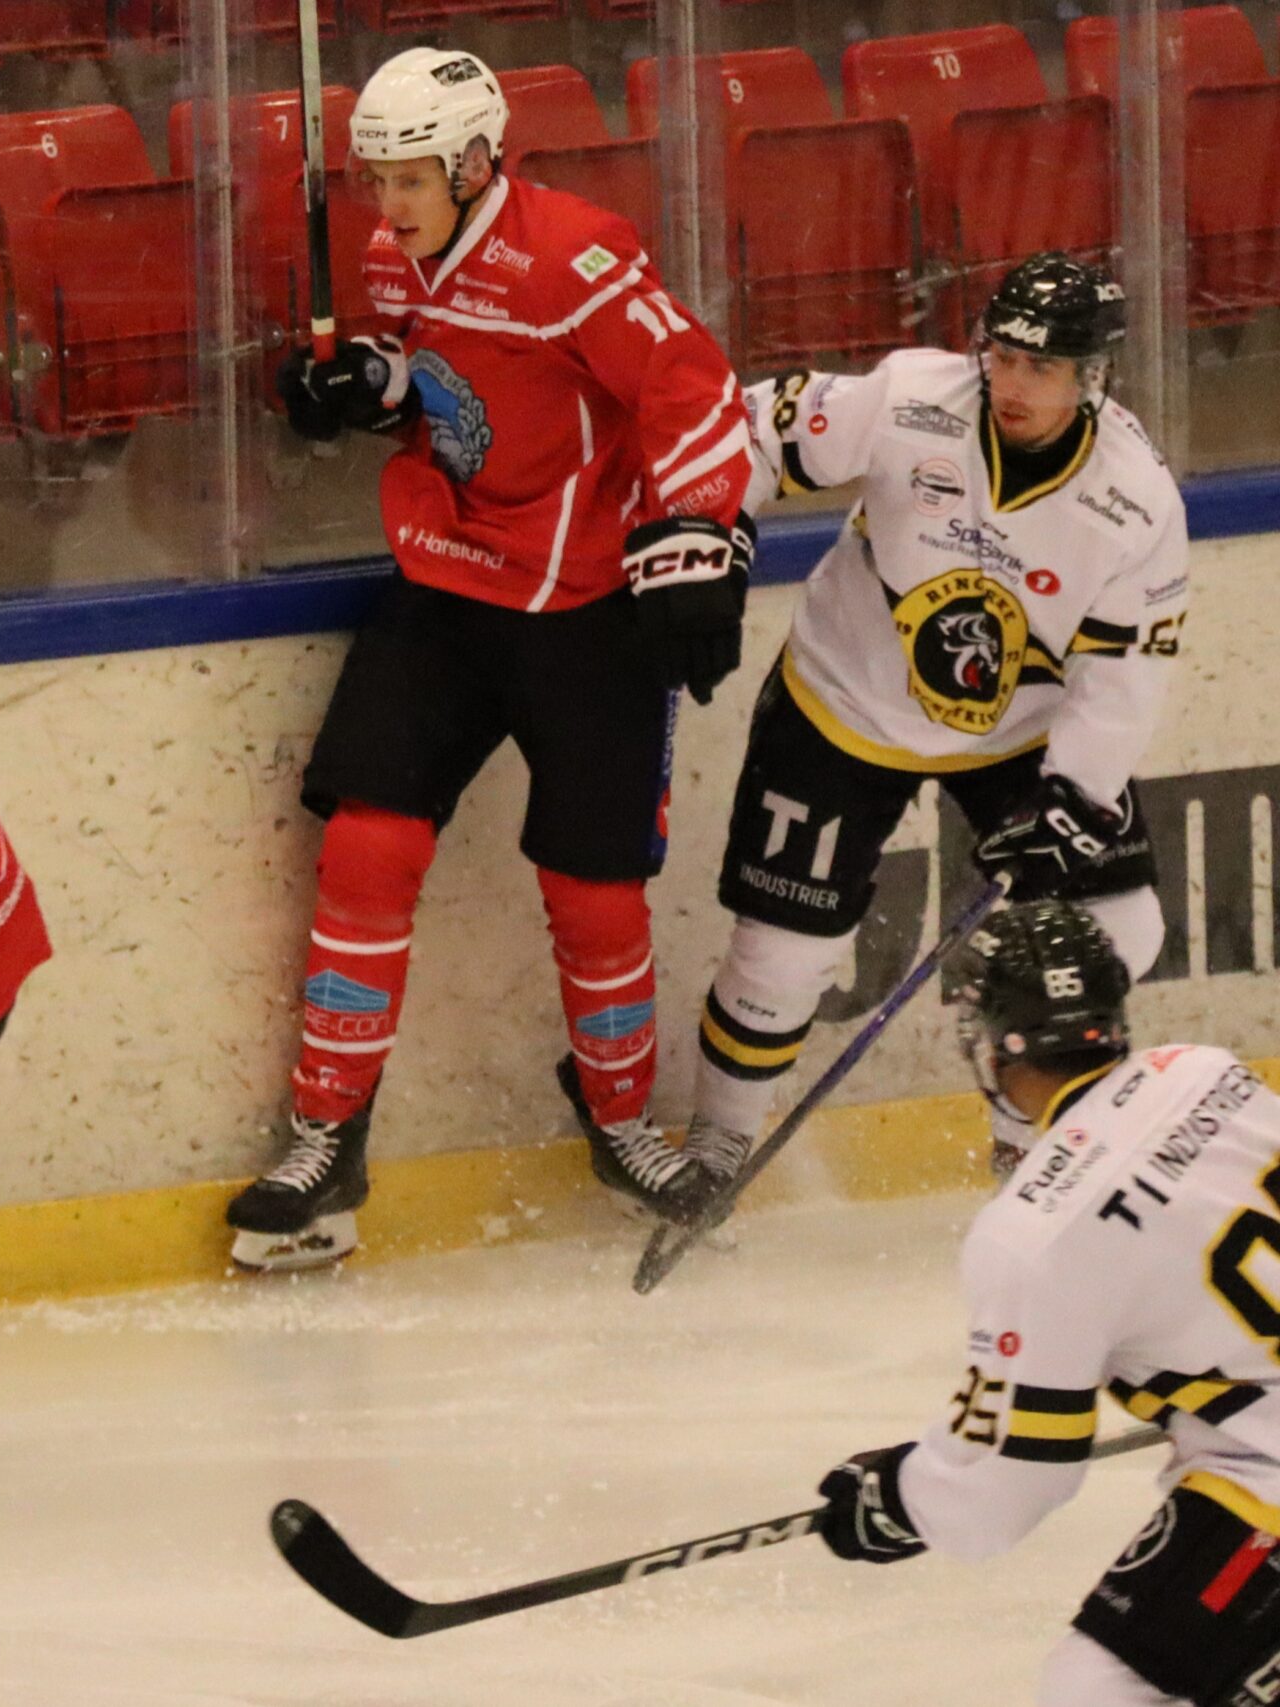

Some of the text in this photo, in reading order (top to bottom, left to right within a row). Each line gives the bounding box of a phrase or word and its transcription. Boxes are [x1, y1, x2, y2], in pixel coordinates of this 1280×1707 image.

[933, 55, 961, 79] 10
[728, 79, 744, 103] 9
[274, 115, 288, 141] 7
[464, 110, 489, 127] CCM
[41, 133, 58, 158] 6
[357, 130, 388, 139] CCM
[739, 863, 840, 911] INDUSTRIER
[1043, 966, 1084, 999] 85
[1017, 1143, 1075, 1204] Fuel
[623, 1511, 813, 1584] CCM
